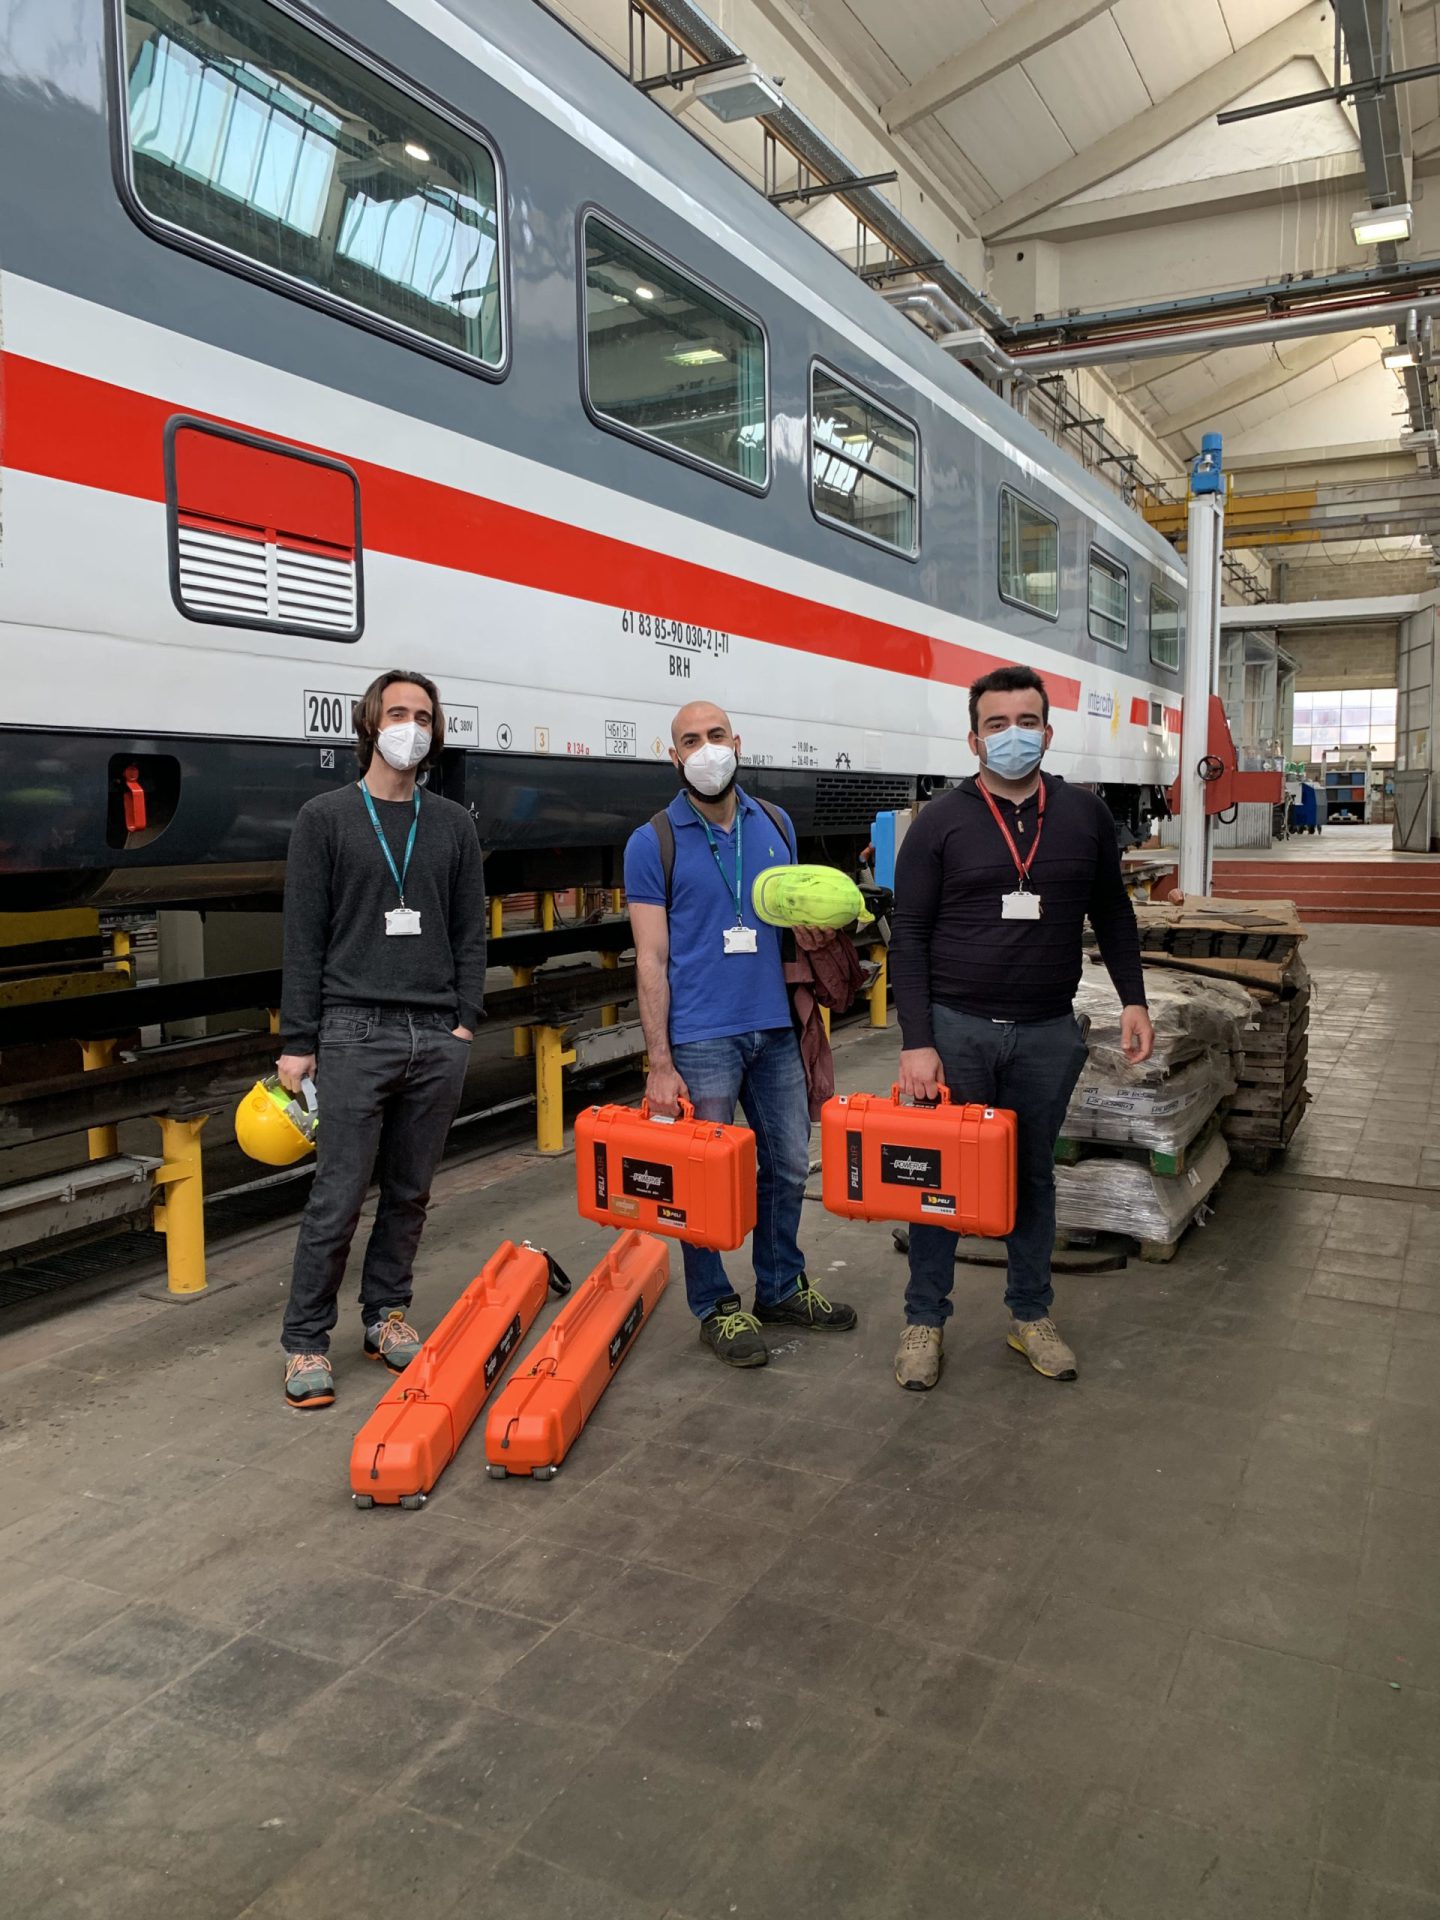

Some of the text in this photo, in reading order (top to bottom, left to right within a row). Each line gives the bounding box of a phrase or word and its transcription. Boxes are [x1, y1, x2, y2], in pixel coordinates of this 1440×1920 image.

[622, 610, 634, 634] 61
[639, 613, 651, 636] 83
[655, 617, 683, 643] 85-90
[685, 625, 712, 650] 030-2
[669, 654, 690, 678] BRH
[309, 696, 342, 733] 200
[1087, 690, 1114, 718] intercity
[447, 716, 458, 733] AC
[539, 732, 545, 748] 3
[567, 742, 572, 753] R
[573, 742, 584, 755] 134
[850, 1144, 859, 1188] PELI AIR
